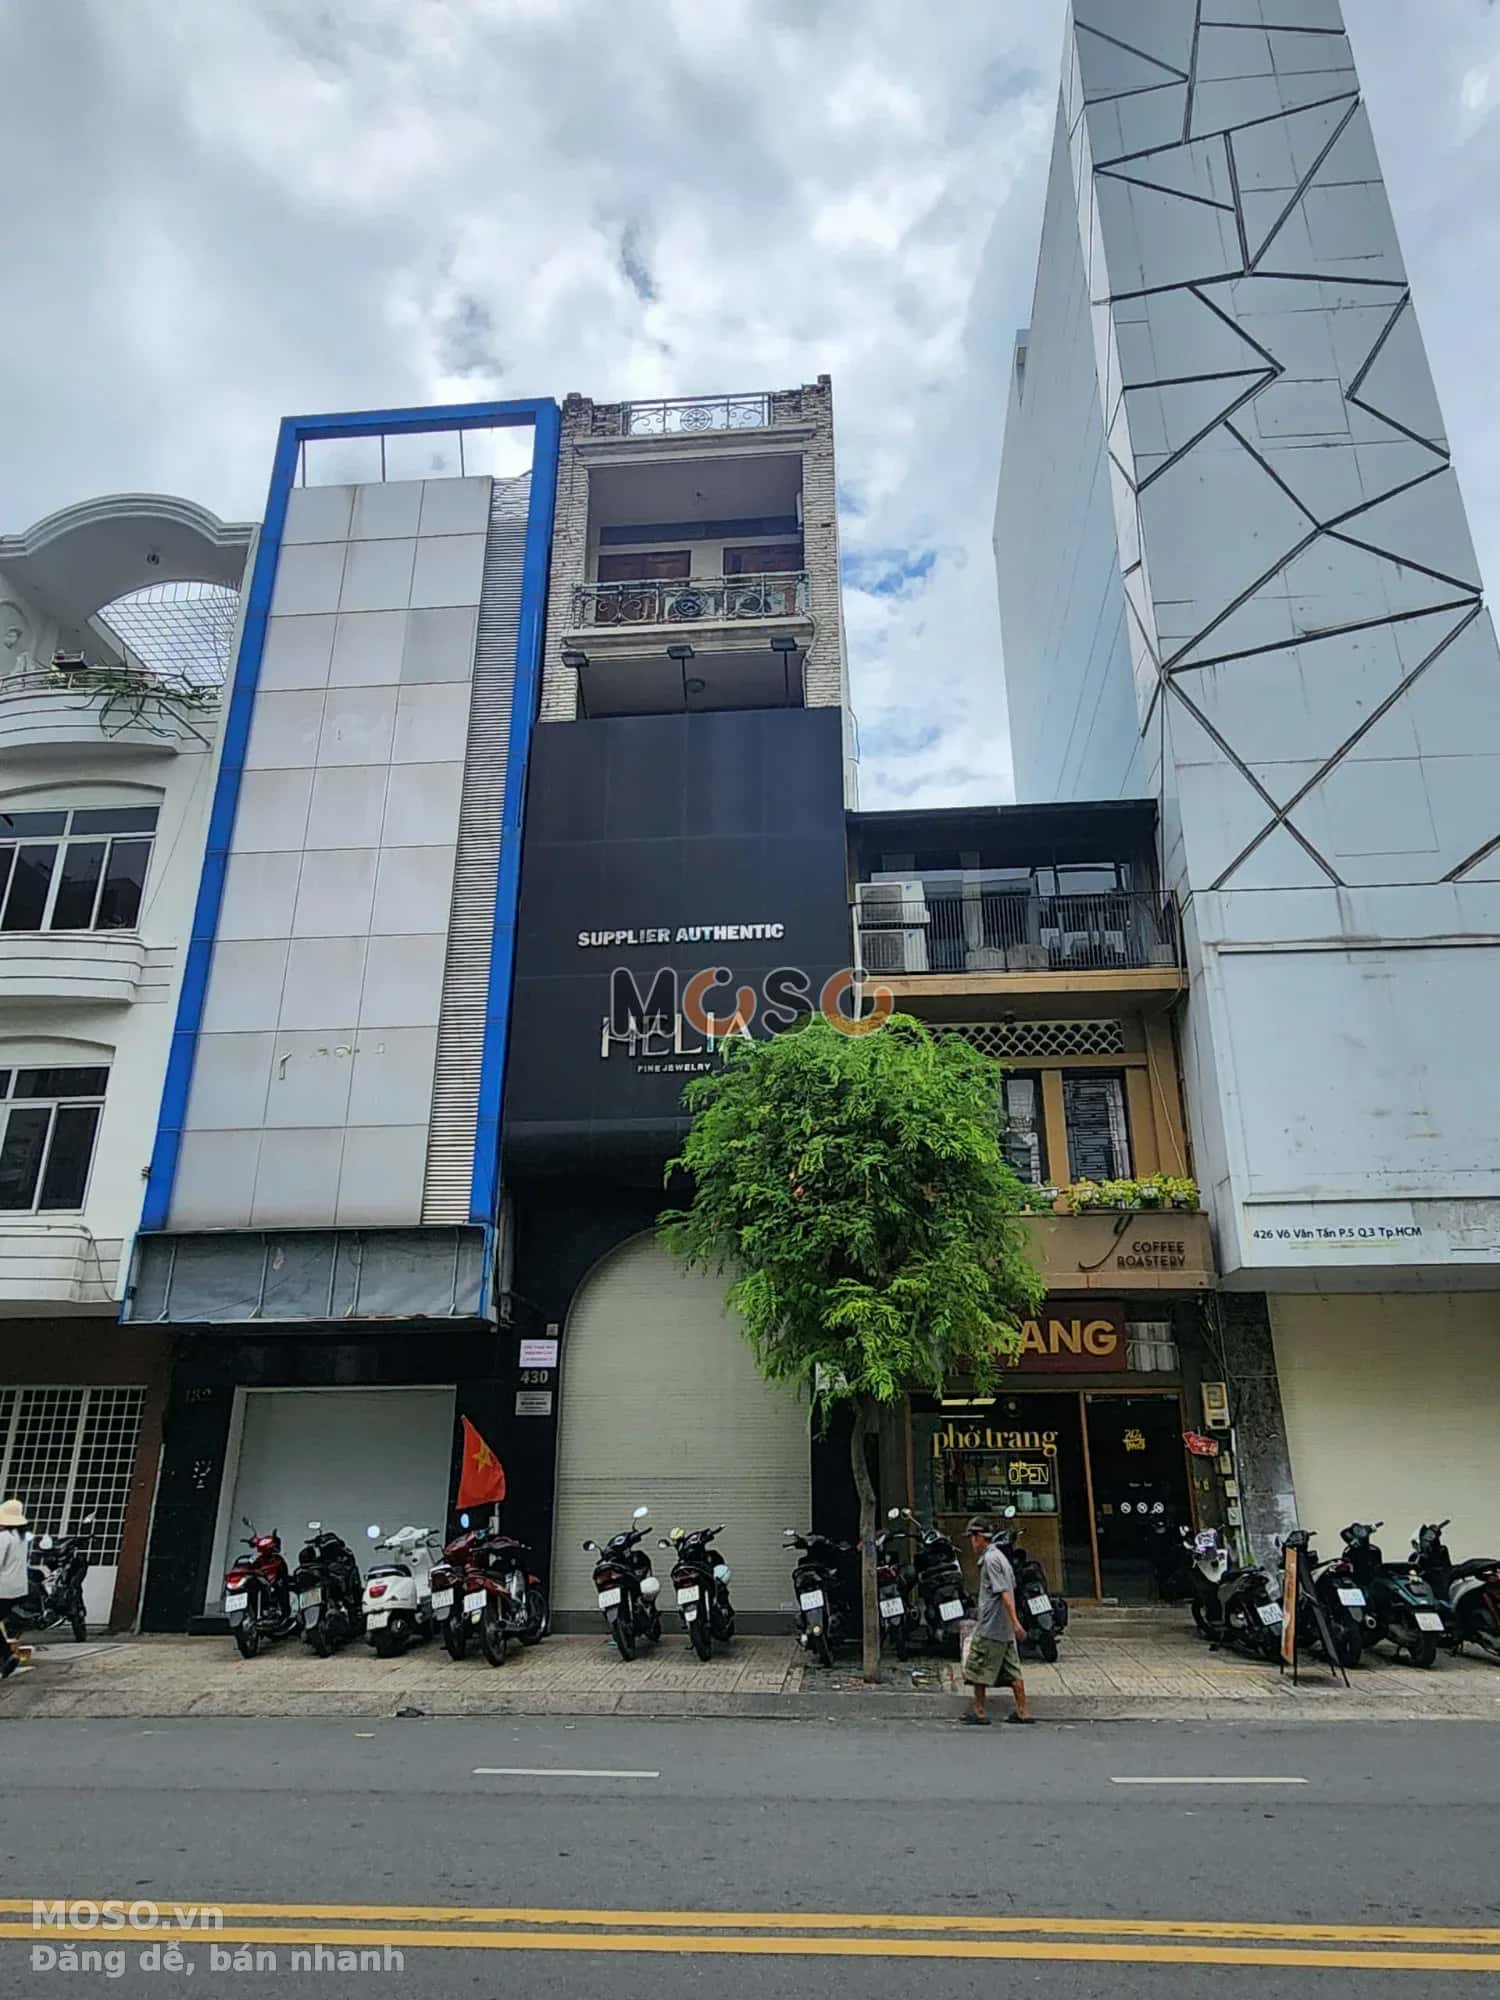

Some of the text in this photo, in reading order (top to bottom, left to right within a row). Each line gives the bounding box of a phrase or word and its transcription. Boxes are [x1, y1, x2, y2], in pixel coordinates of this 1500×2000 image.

[577, 923, 785, 947] SUPPLIER AUTHENTIC
[1253, 1229, 1273, 1239] 426
[1132, 1241, 1185, 1253] COFFEE
[1117, 1255, 1186, 1268] ROASTERY
[520, 1370, 548, 1384] 430
[986, 1428, 1058, 1457] trang
[1008, 1466, 1049, 1482] OPEN
